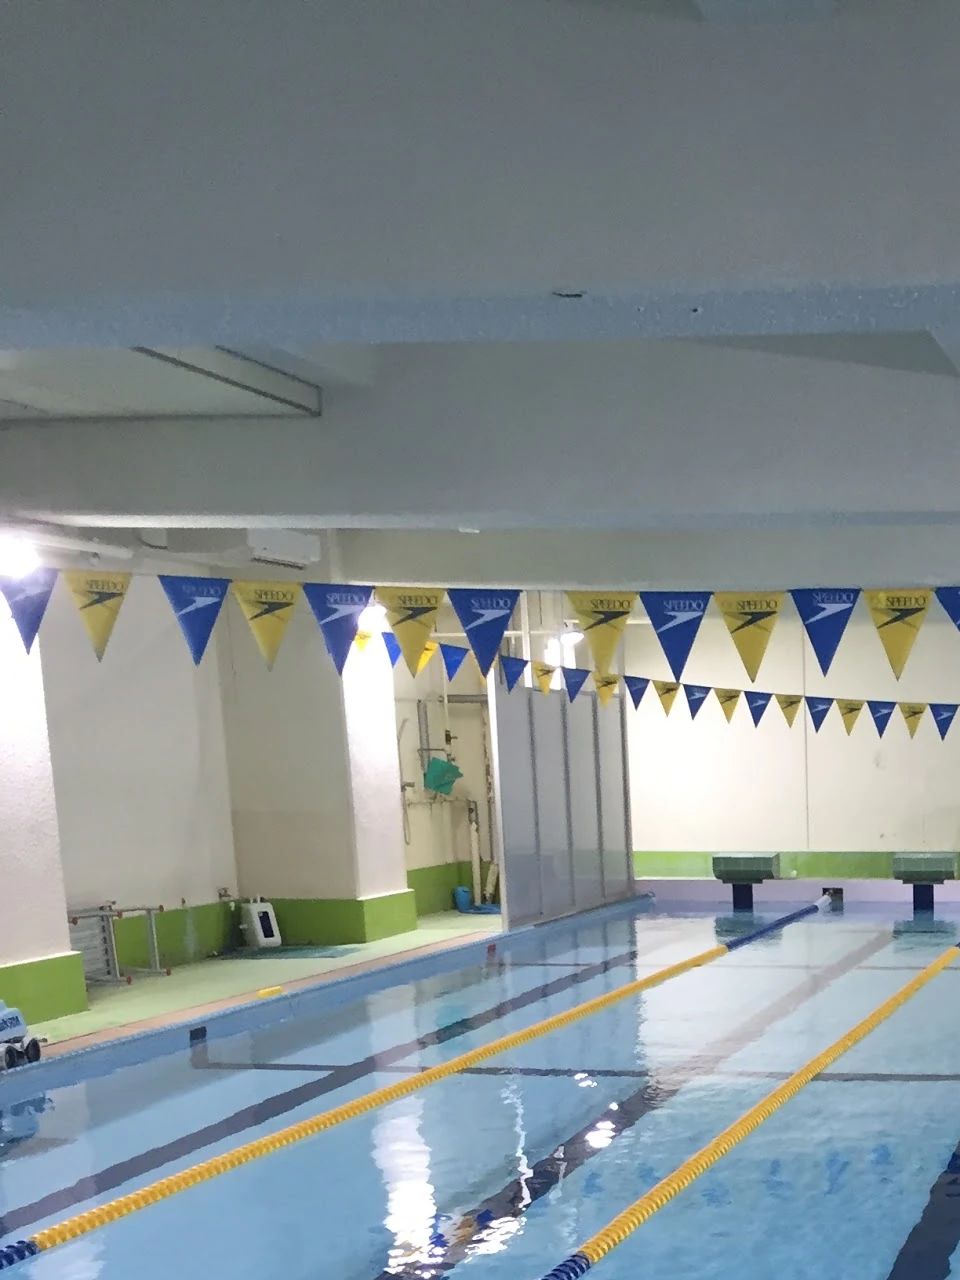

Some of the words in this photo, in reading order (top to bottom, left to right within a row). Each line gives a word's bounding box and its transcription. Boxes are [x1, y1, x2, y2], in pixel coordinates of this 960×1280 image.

[254, 589, 294, 600] SPEEDO
[812, 592, 854, 602] SPEEDO
[471, 599, 511, 609] SPEEDO
[591, 599, 631, 609] SPEEDO
[663, 601, 703, 611] SPEEDO
[736, 600, 778, 610] SPEEDO
[886, 596, 926, 606] SPEEDO
